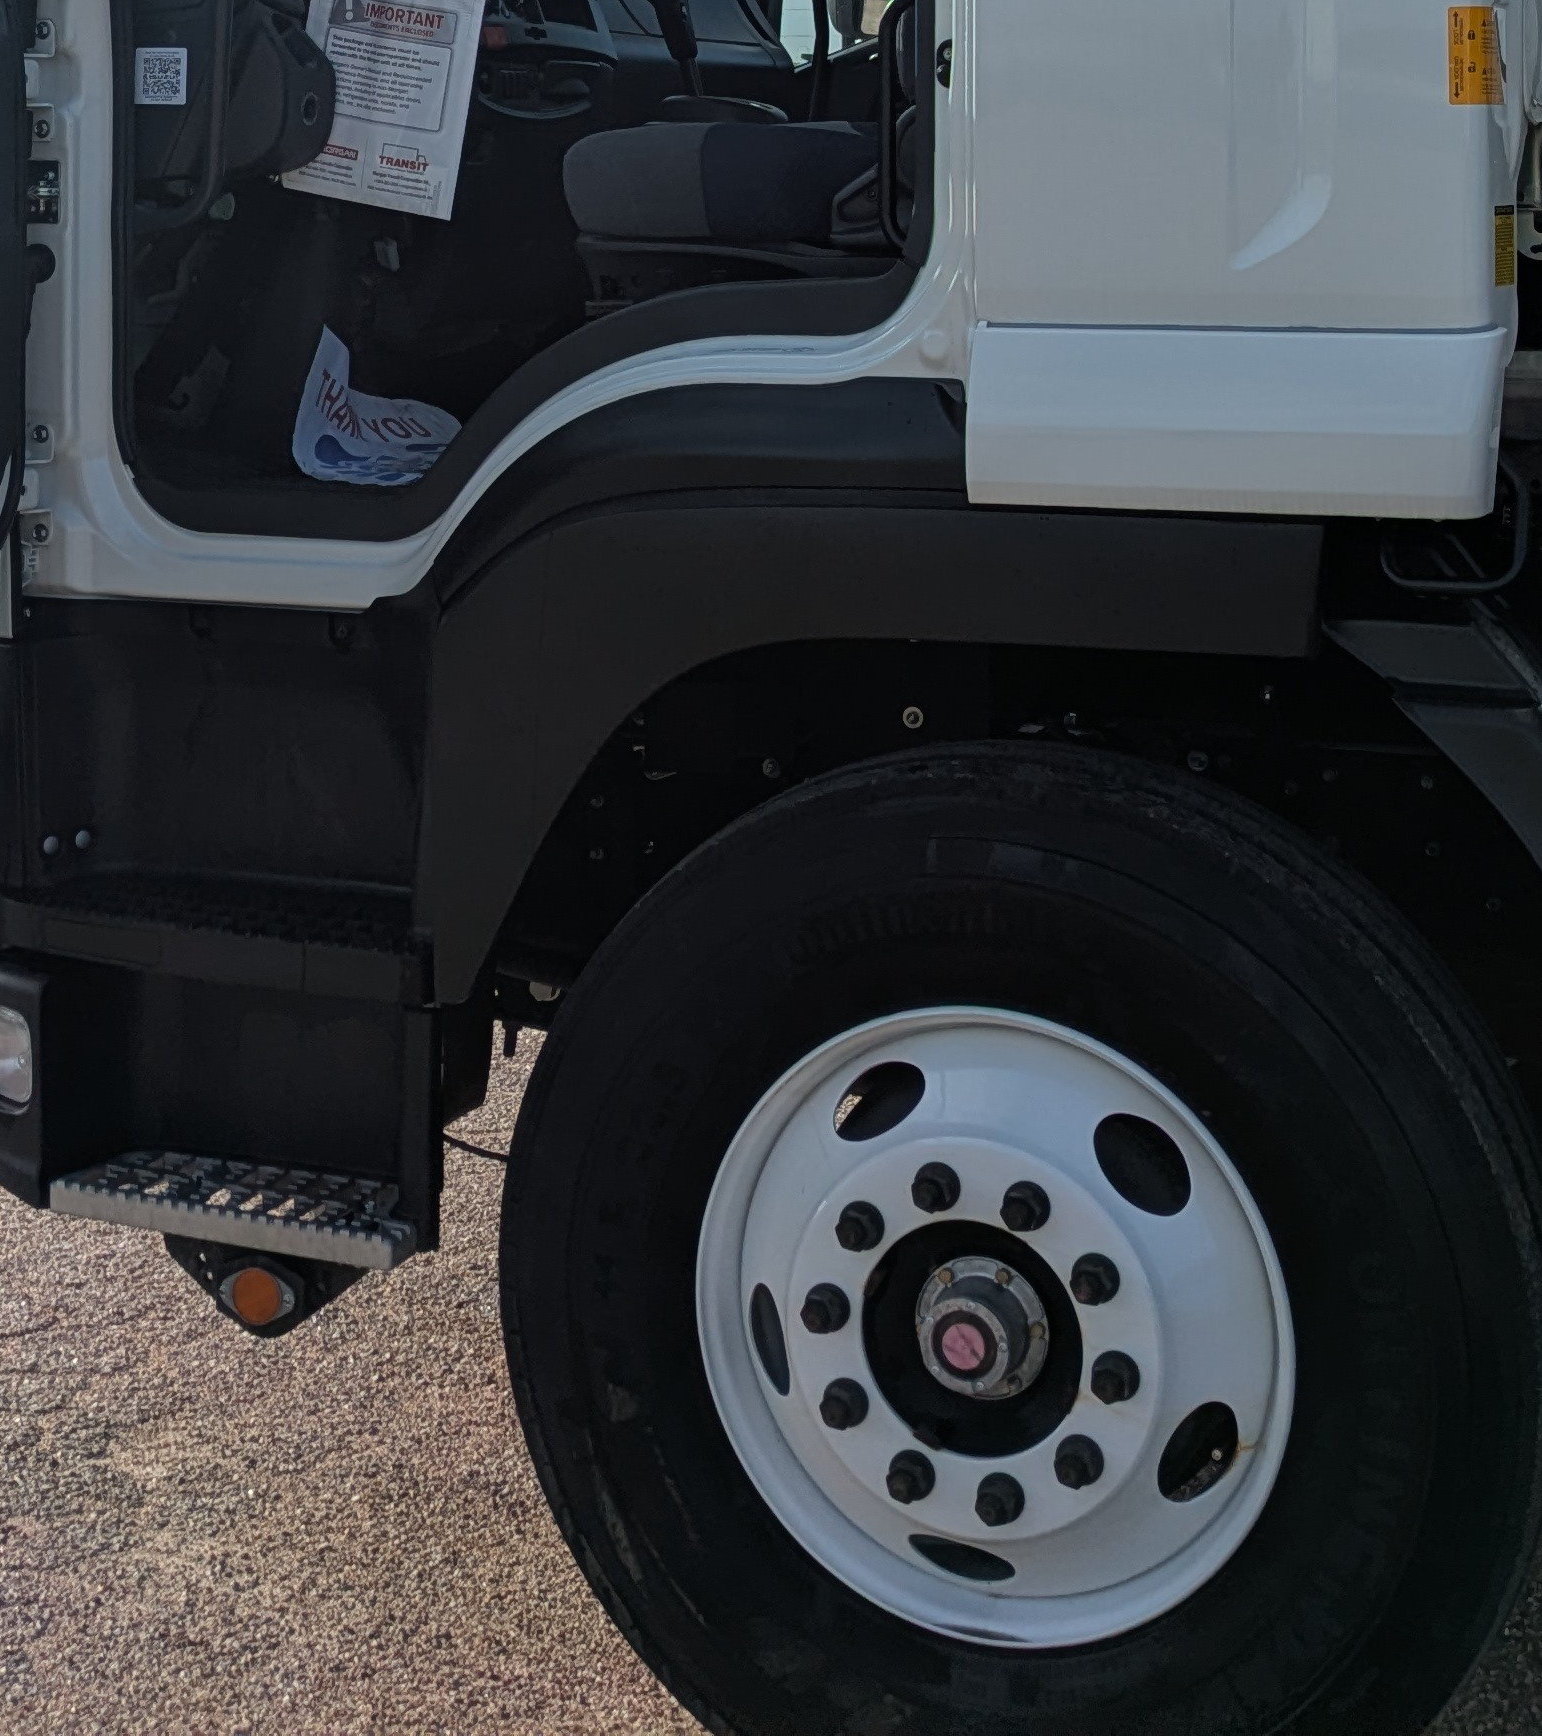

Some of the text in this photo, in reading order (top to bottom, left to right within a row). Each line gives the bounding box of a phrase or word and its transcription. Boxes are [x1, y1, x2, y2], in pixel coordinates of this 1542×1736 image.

[365, 2, 445, 30] IMPORTANT
[379, 155, 429, 172] TRANSIT
[316, 368, 432, 443] THAN YOU
